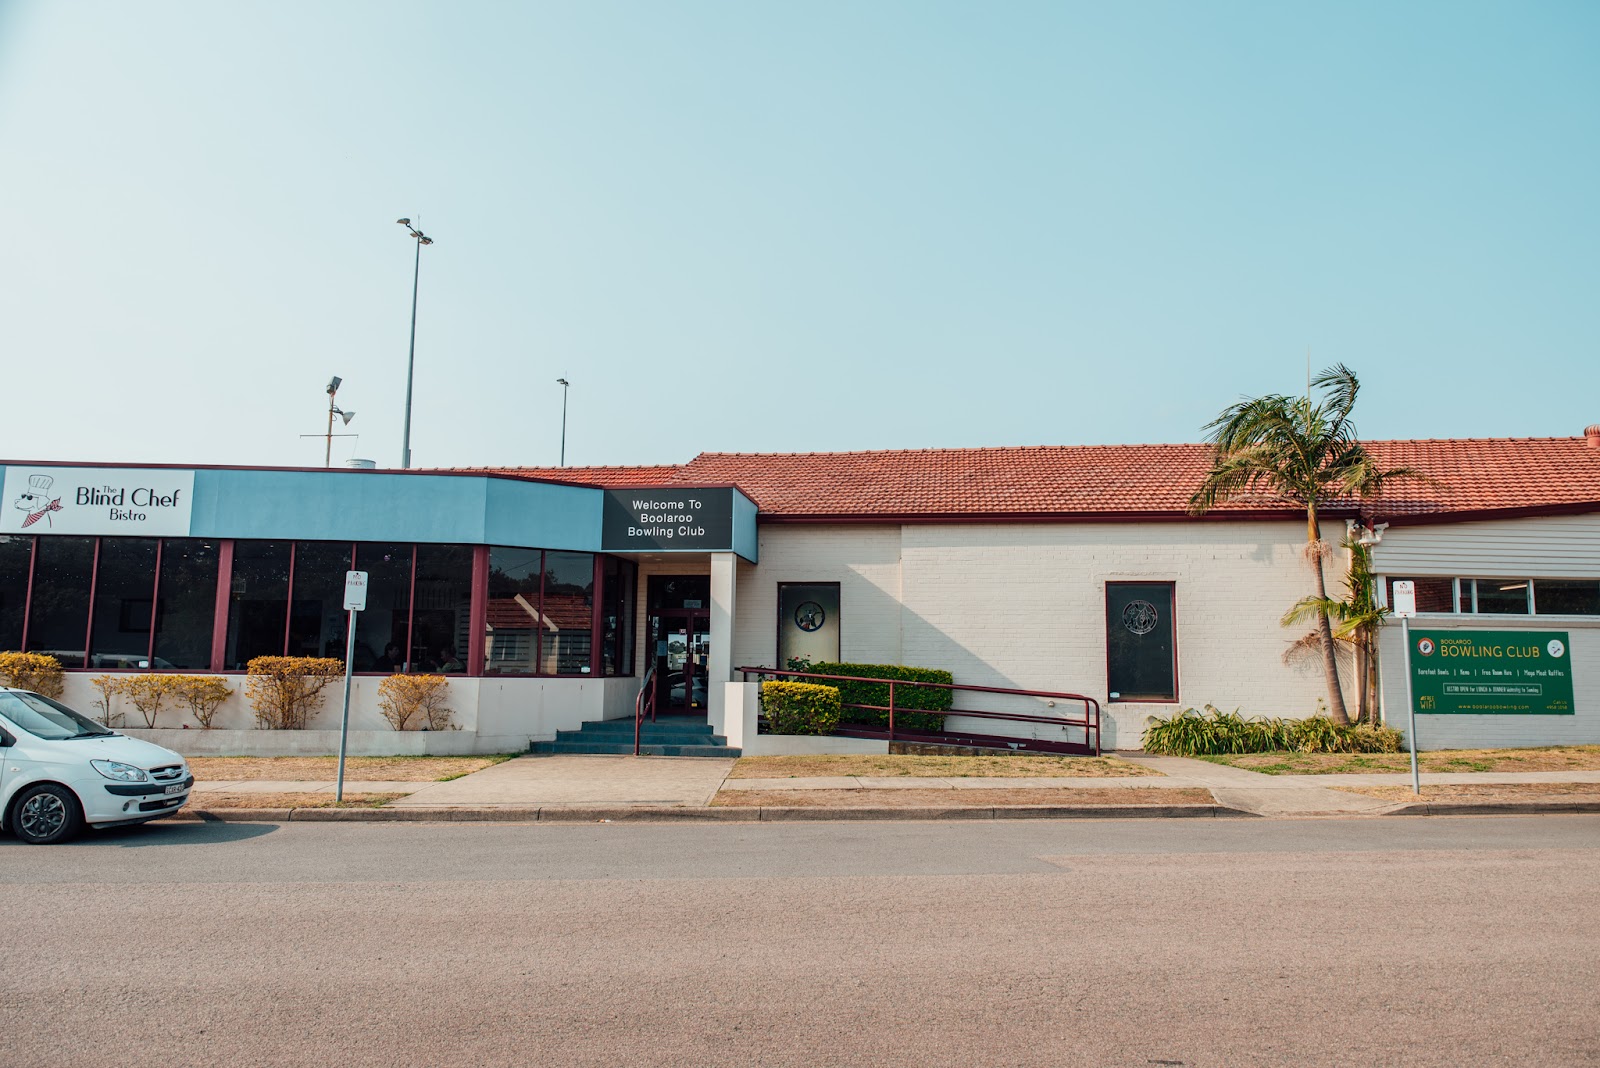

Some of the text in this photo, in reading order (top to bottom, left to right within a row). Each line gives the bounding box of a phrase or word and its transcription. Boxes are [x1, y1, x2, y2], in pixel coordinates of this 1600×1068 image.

[103, 486, 117, 494] The
[76, 486, 181, 507] Blind Chef
[632, 500, 702, 510] Welcome To
[110, 508, 146, 521] Bistro
[640, 513, 693, 523] Boolaroo
[628, 526, 705, 538] Bowling Club
[1440, 645, 1540, 658] BOWLING CLUB
